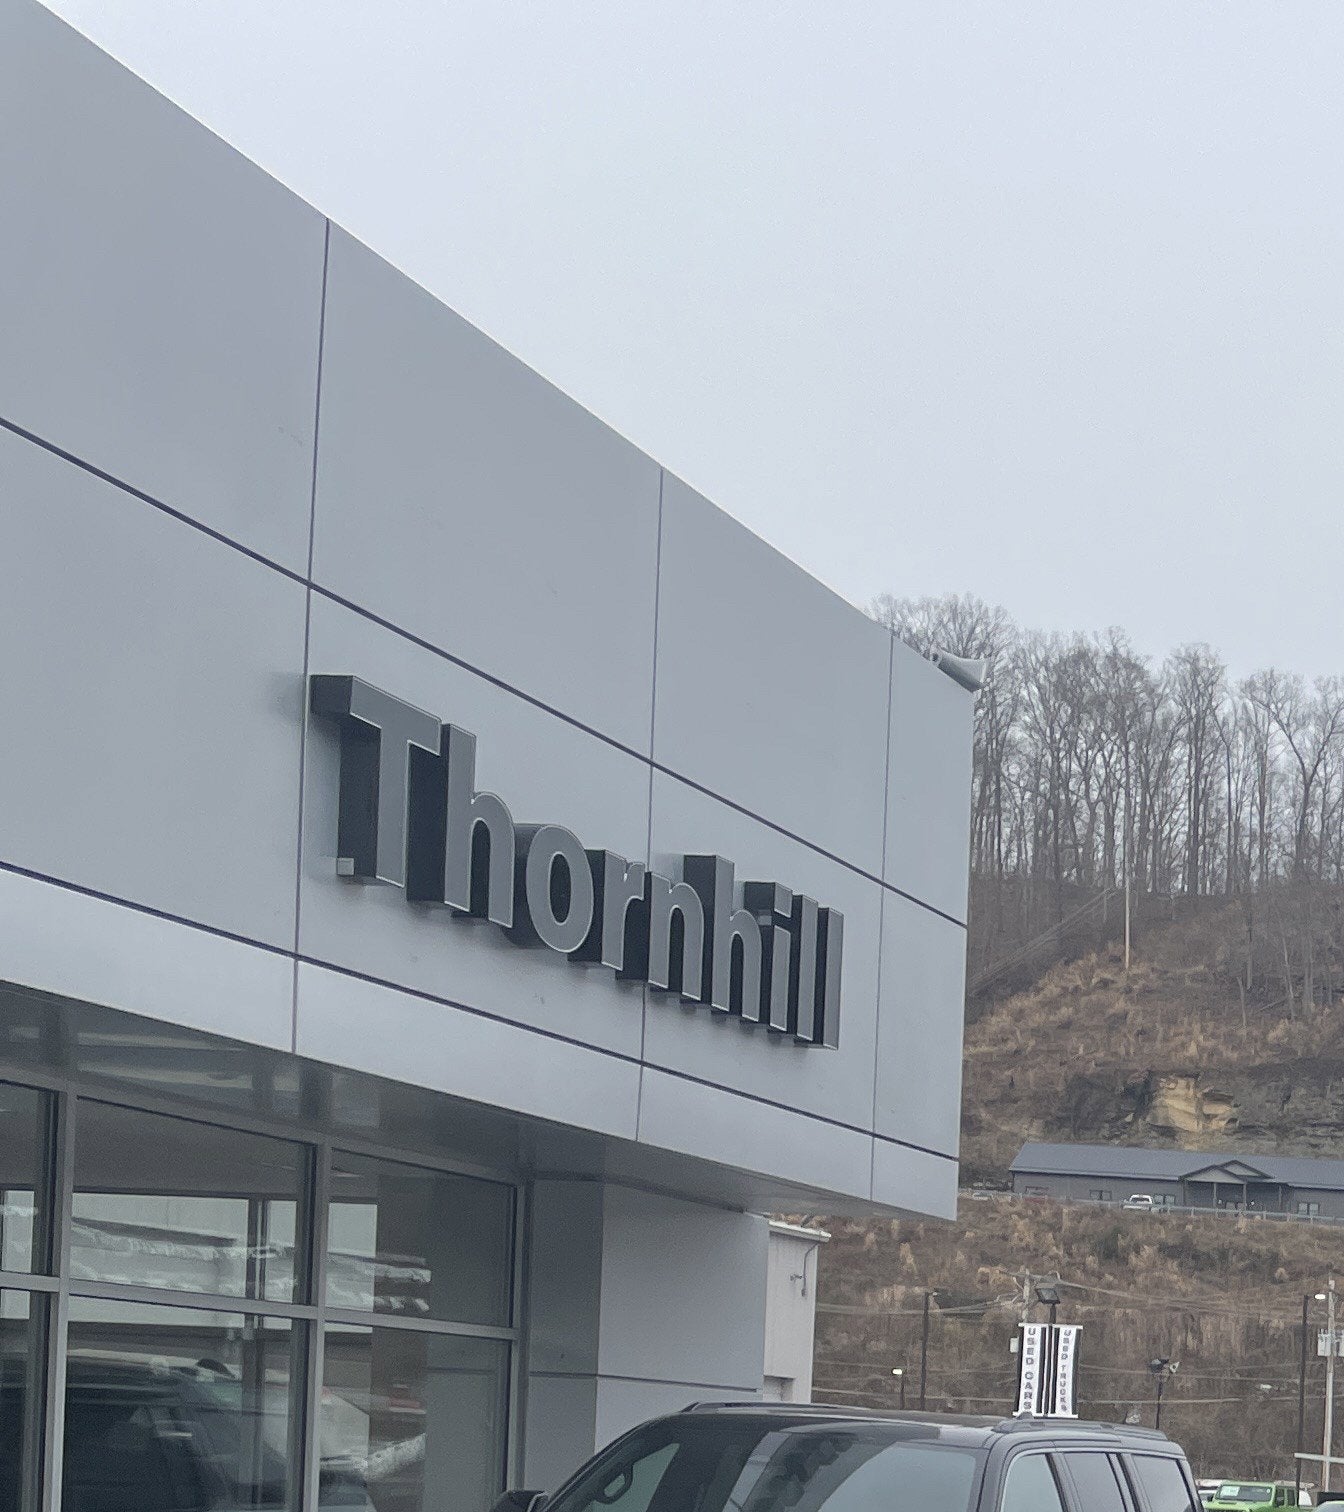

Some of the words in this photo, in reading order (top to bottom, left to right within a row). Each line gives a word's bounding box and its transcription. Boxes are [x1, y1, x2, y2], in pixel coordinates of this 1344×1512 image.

[311, 675, 844, 1050] Thornhill
[1026, 1327, 1036, 1365] USED
[1023, 1371, 1034, 1409] CARS
